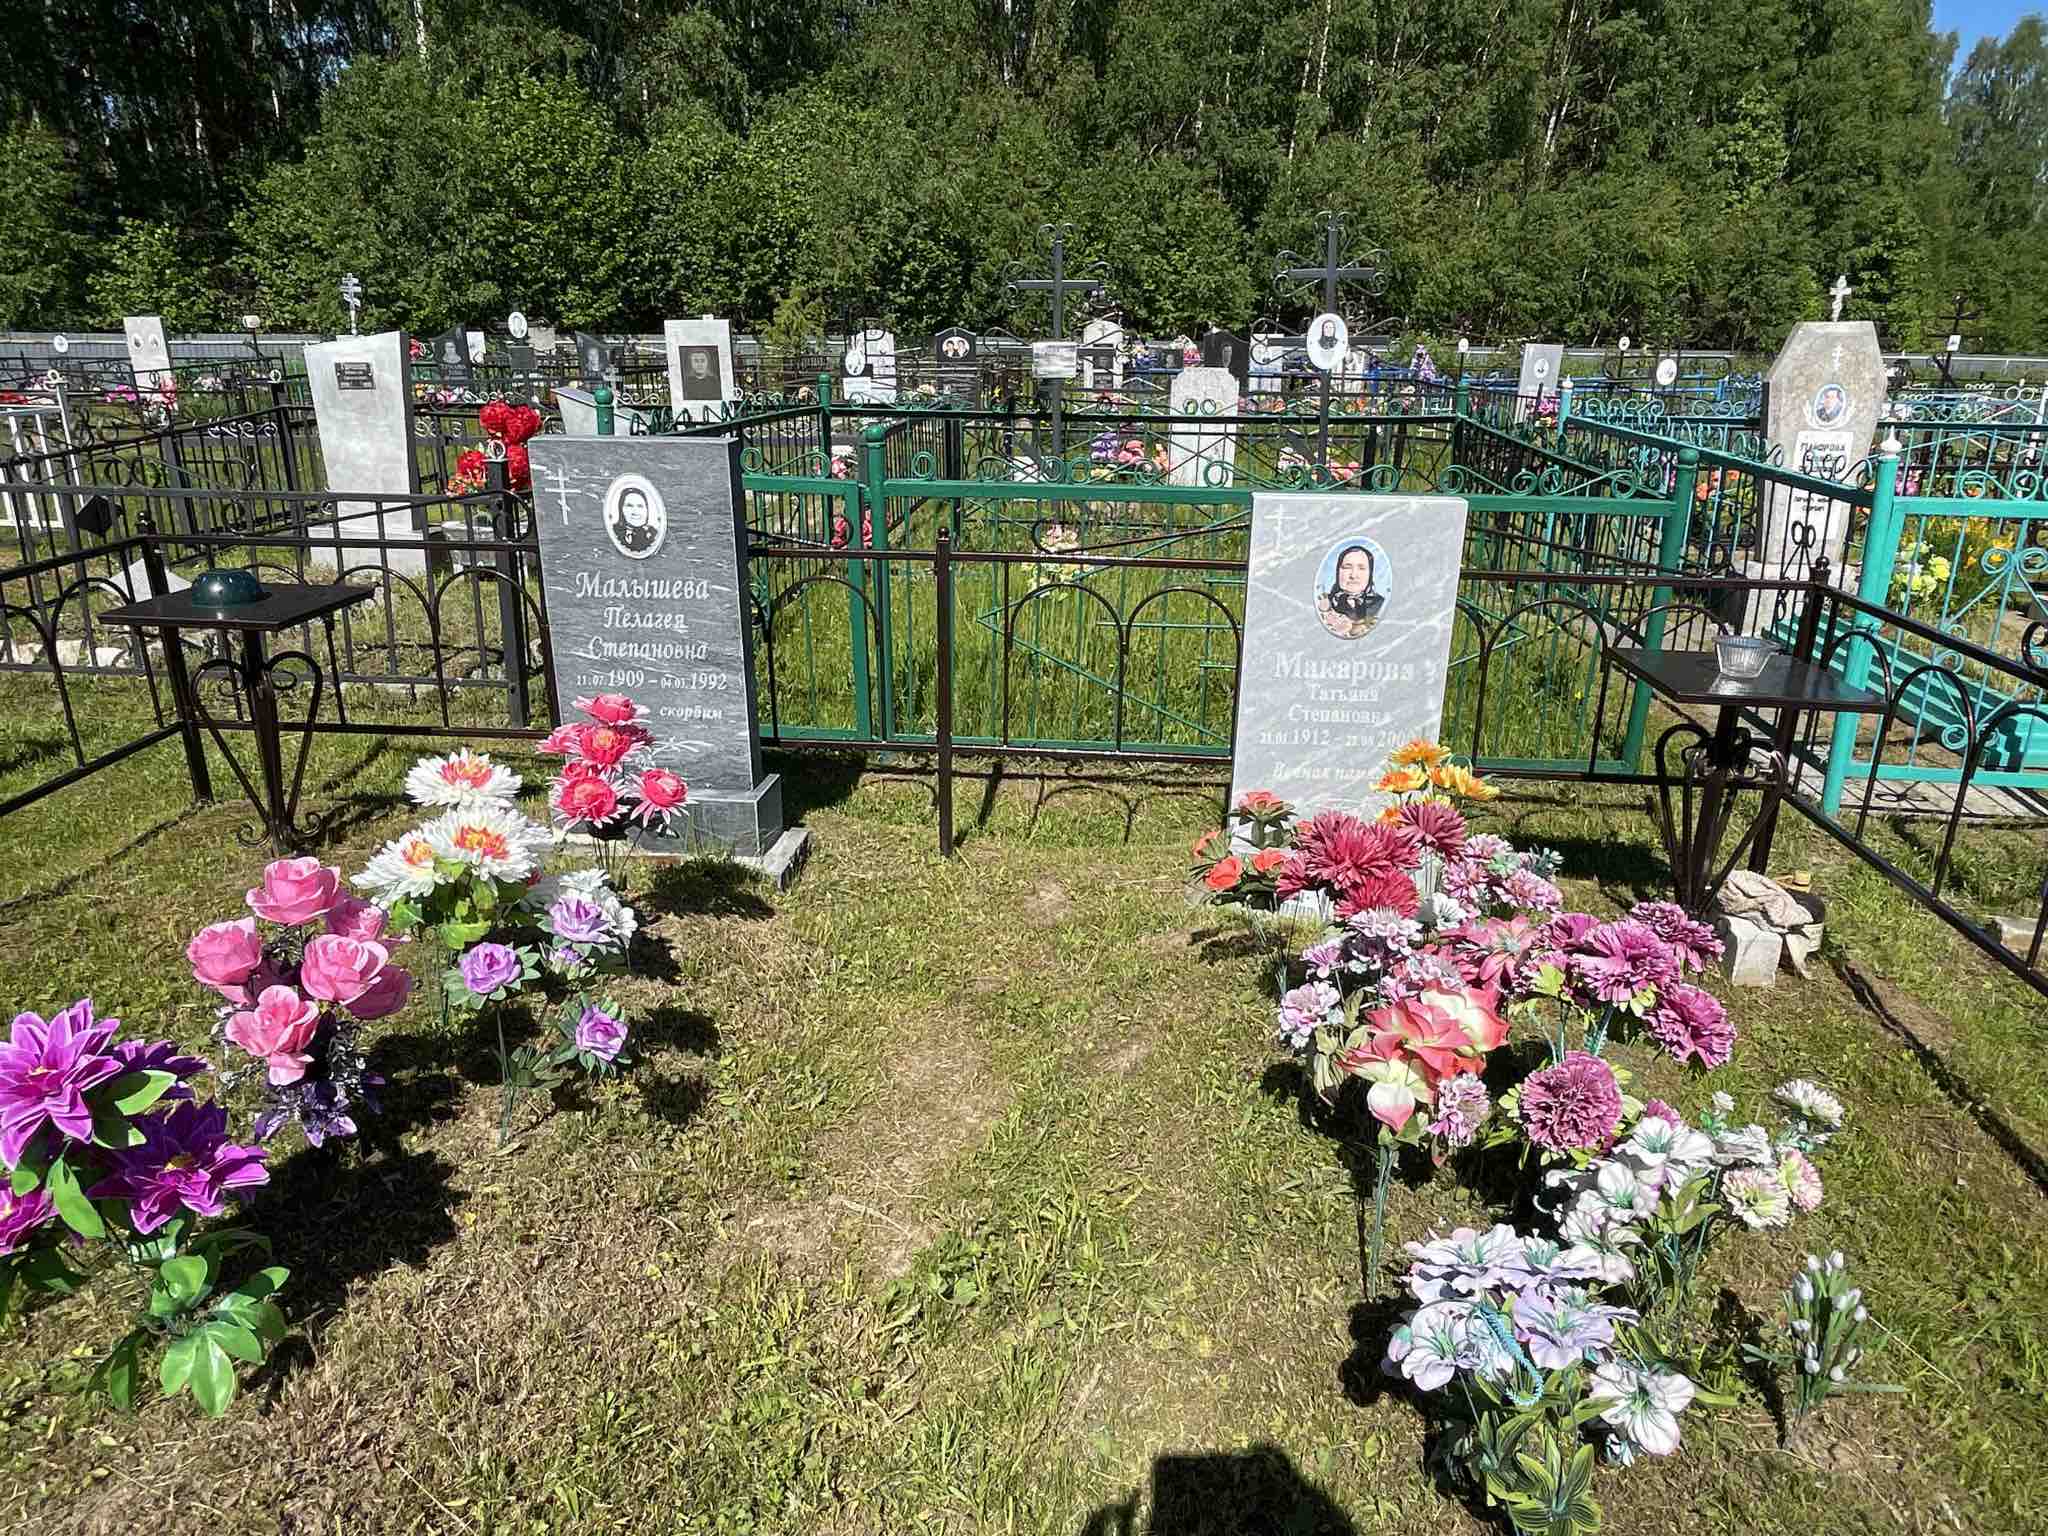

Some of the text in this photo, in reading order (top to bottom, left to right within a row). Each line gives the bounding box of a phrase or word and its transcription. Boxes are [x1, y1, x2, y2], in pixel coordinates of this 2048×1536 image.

[576, 570, 710, 599] Малышева
[603, 604, 688, 630] Пелагея
[588, 635, 709, 660] Степановна
[1272, 651, 1415, 687] Макарова
